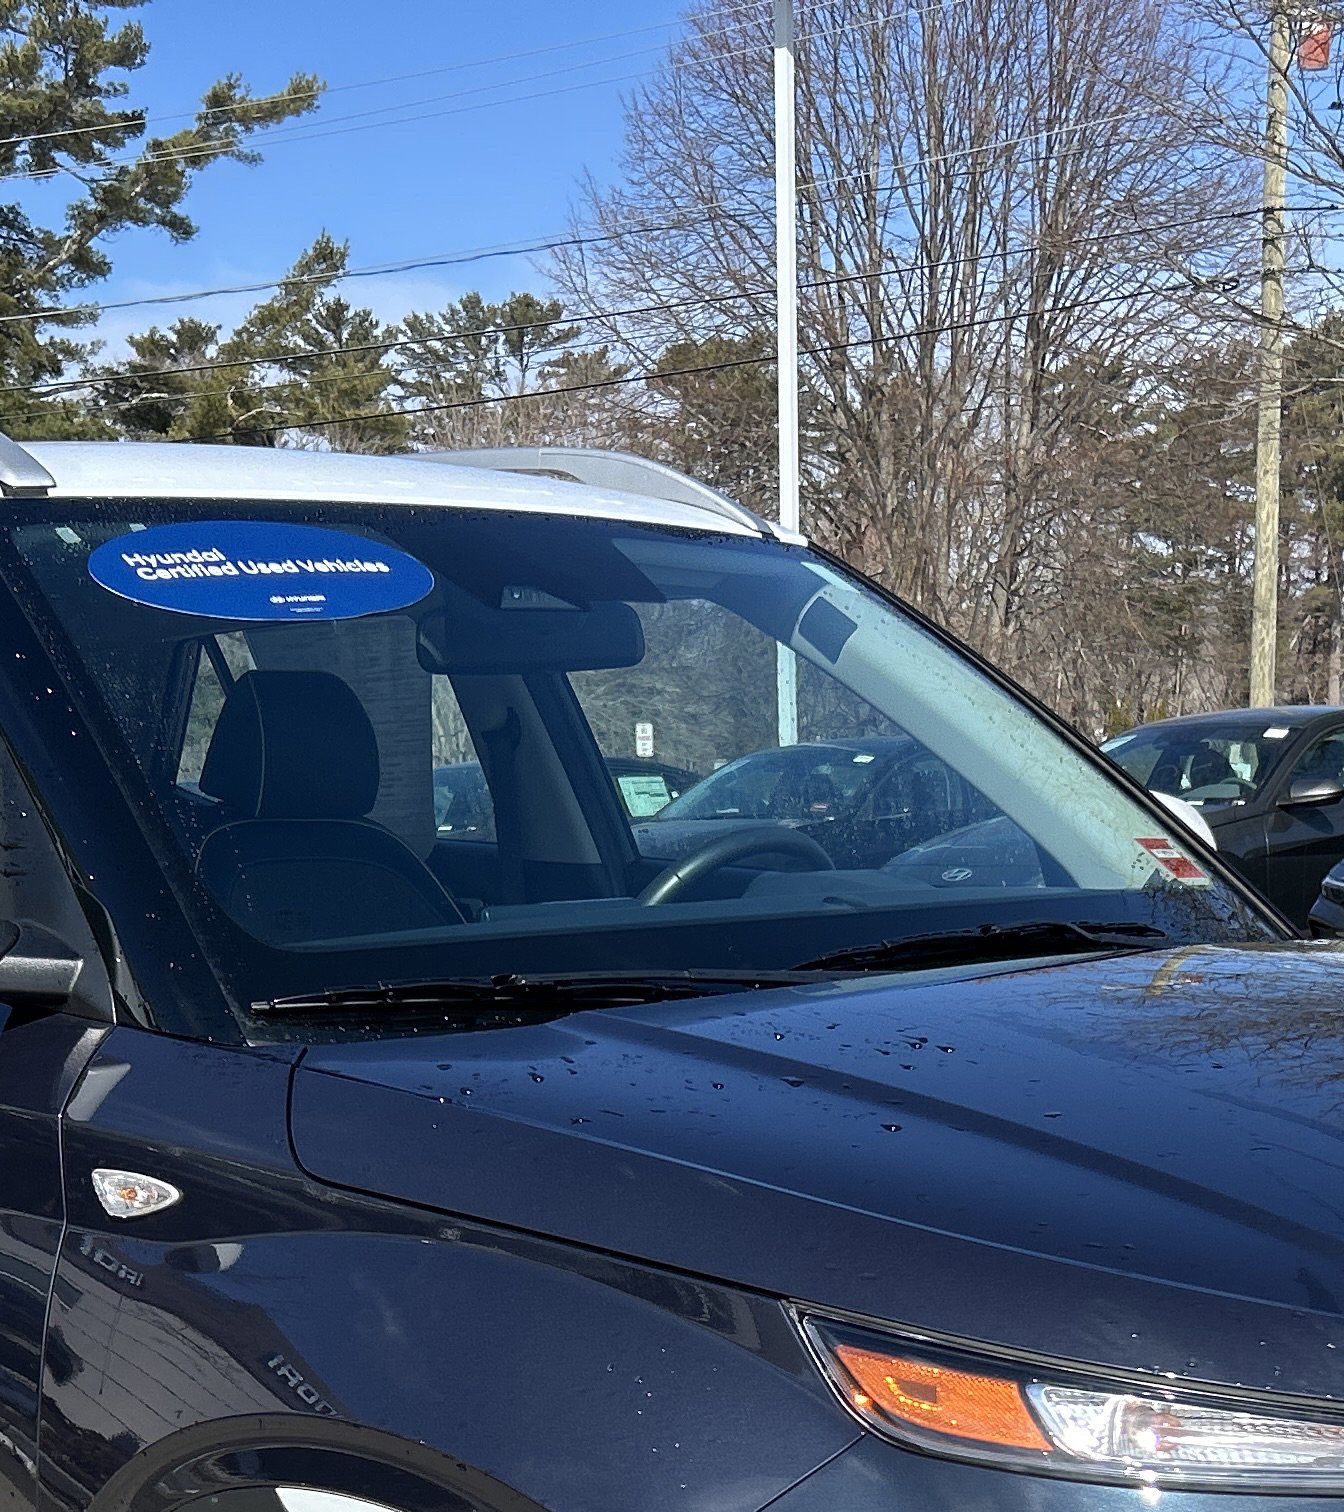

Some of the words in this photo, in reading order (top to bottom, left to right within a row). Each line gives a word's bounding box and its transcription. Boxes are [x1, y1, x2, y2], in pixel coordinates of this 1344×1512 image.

[121, 547, 227, 567] Hyundai
[136, 559, 239, 581] Certified
[240, 560, 305, 575] Used
[303, 557, 391, 574] Vehicles
